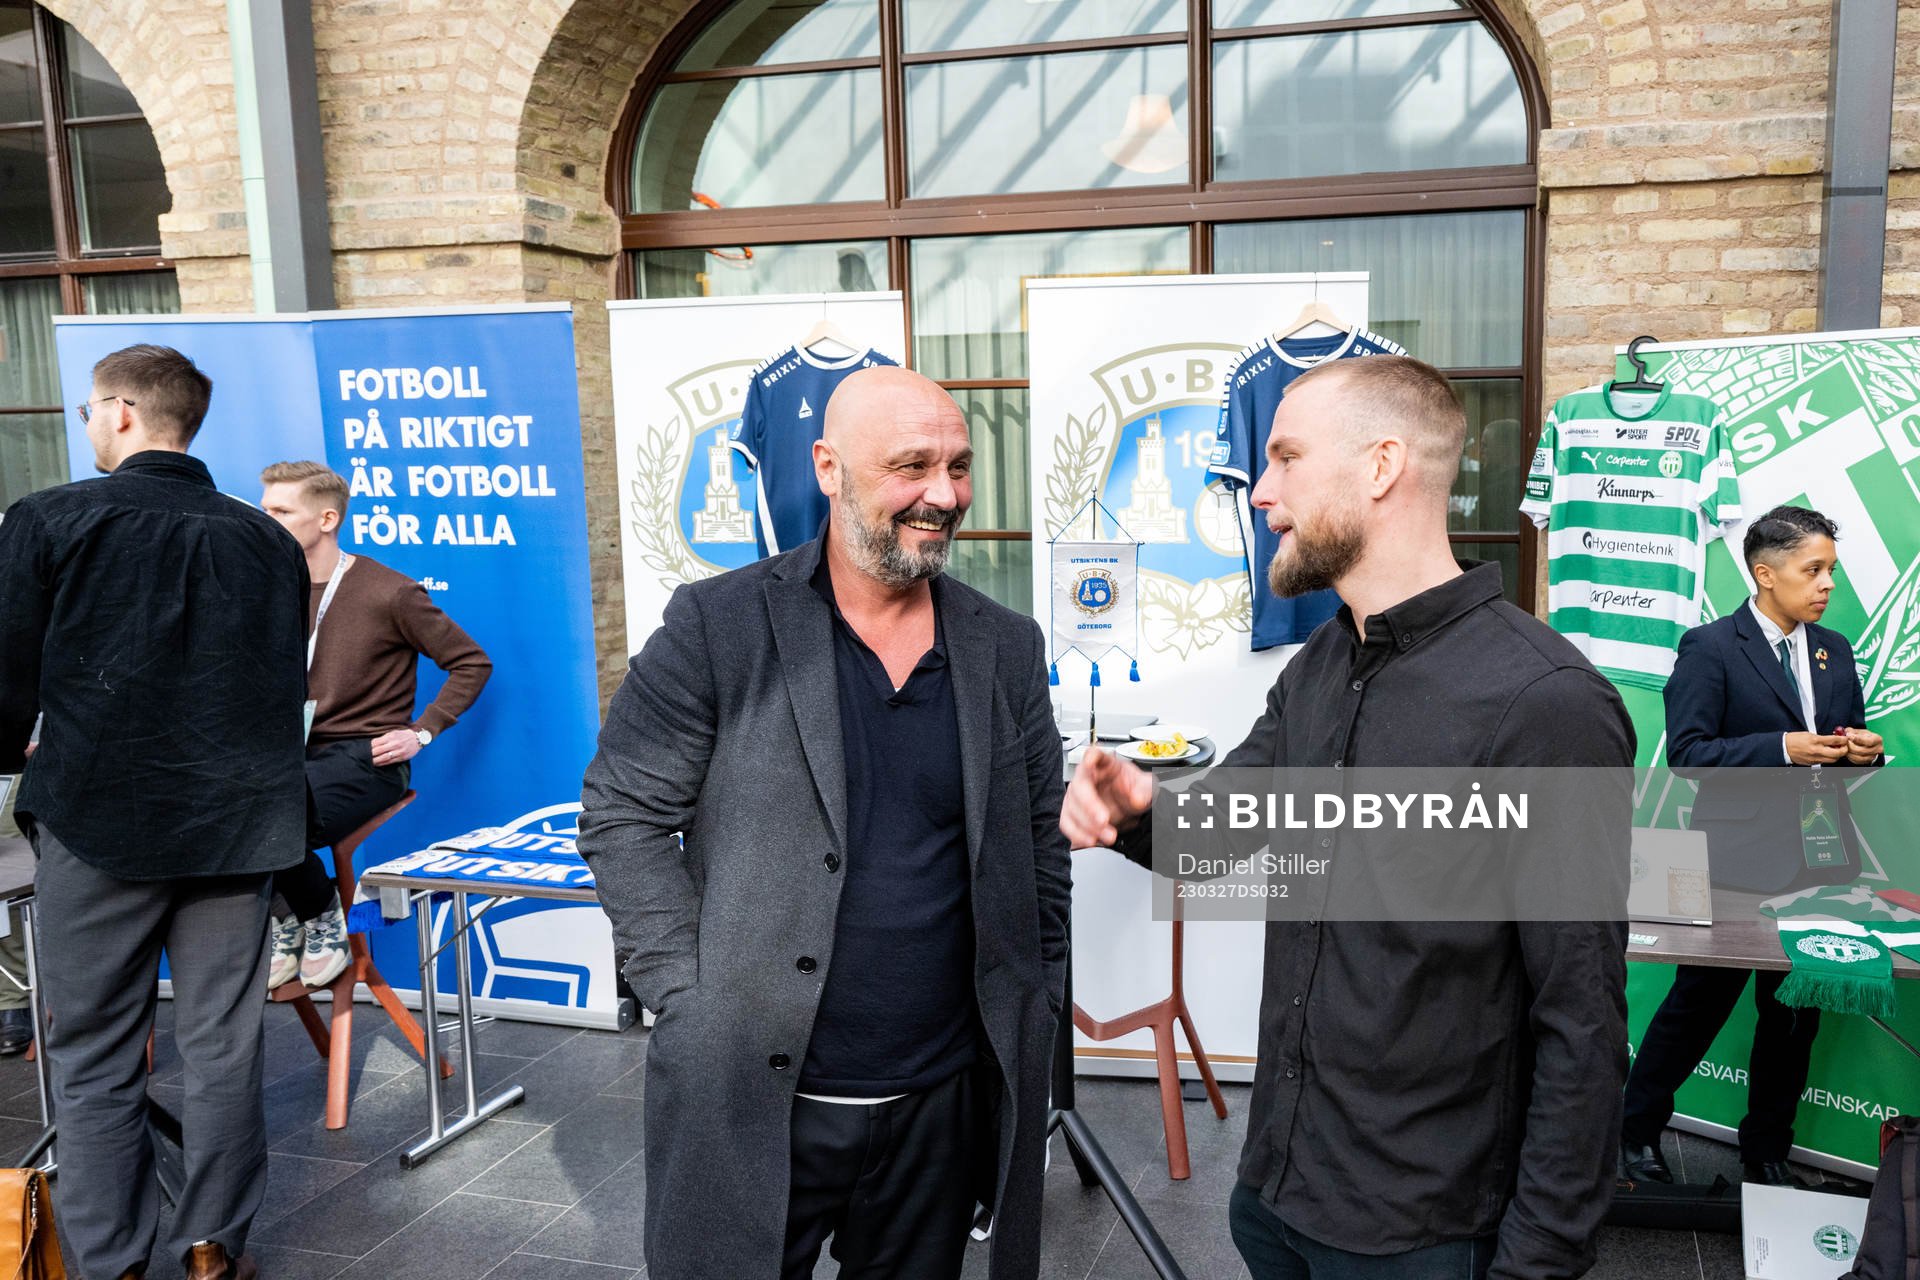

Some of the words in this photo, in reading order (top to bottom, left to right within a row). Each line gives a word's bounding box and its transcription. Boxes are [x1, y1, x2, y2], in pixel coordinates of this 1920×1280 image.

[339, 366, 487, 401] FOTBOLL
[763, 356, 802, 387] BRIXLY
[344, 408, 389, 449] PÅ
[400, 415, 533, 448] RIKTIGT
[1665, 426, 1701, 444] SPOL
[1606, 455, 1650, 467] Carpenter
[350, 457, 396, 497] ÄR
[407, 465, 556, 497] FOTBOLL
[1597, 477, 1656, 502] Kinnarps
[352, 505, 423, 545] FÖR
[432, 514, 517, 545] ALLA
[1592, 537, 1674, 556] Hygienteknik
[1590, 590, 1656, 609] arpenter
[1693, 1061, 1748, 1086] SVAR
[1801, 1087, 1900, 1121] MENSKAP
